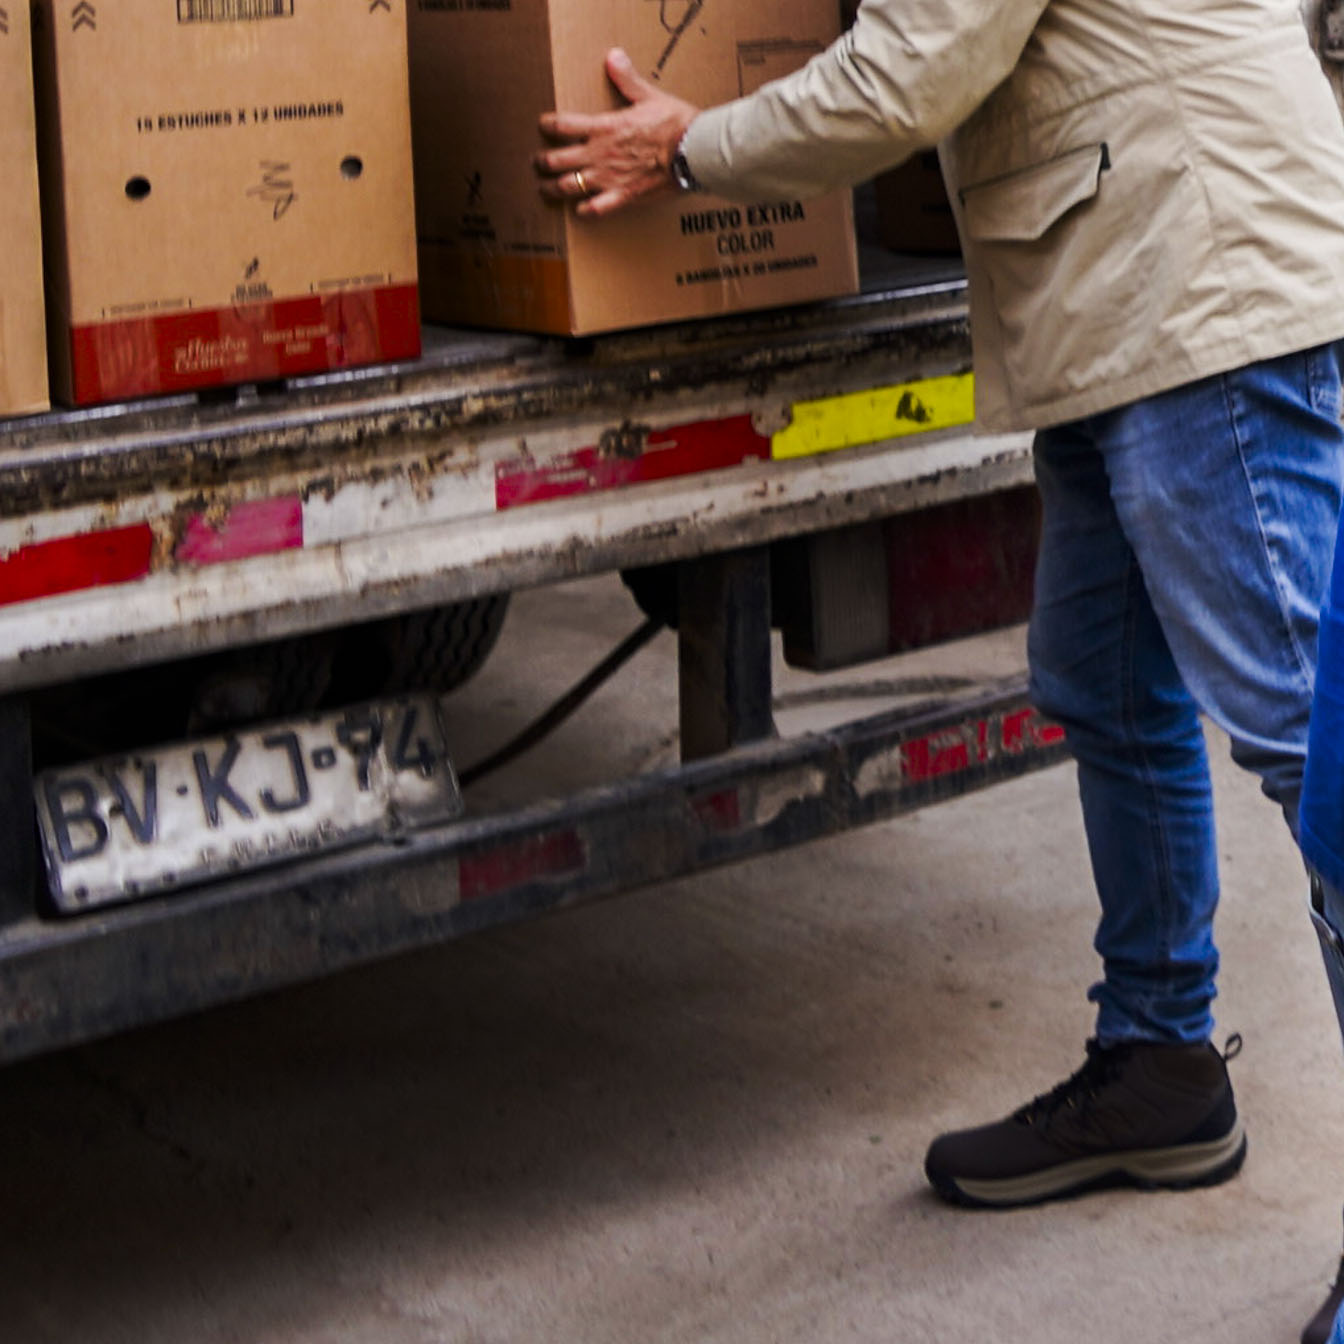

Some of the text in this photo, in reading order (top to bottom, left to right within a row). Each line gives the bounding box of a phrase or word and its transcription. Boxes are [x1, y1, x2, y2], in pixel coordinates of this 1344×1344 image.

[273, 100, 344, 121] UNIDADES
[680, 200, 806, 236] HUEVO EXTRA
[716, 228, 775, 255] COLOR
